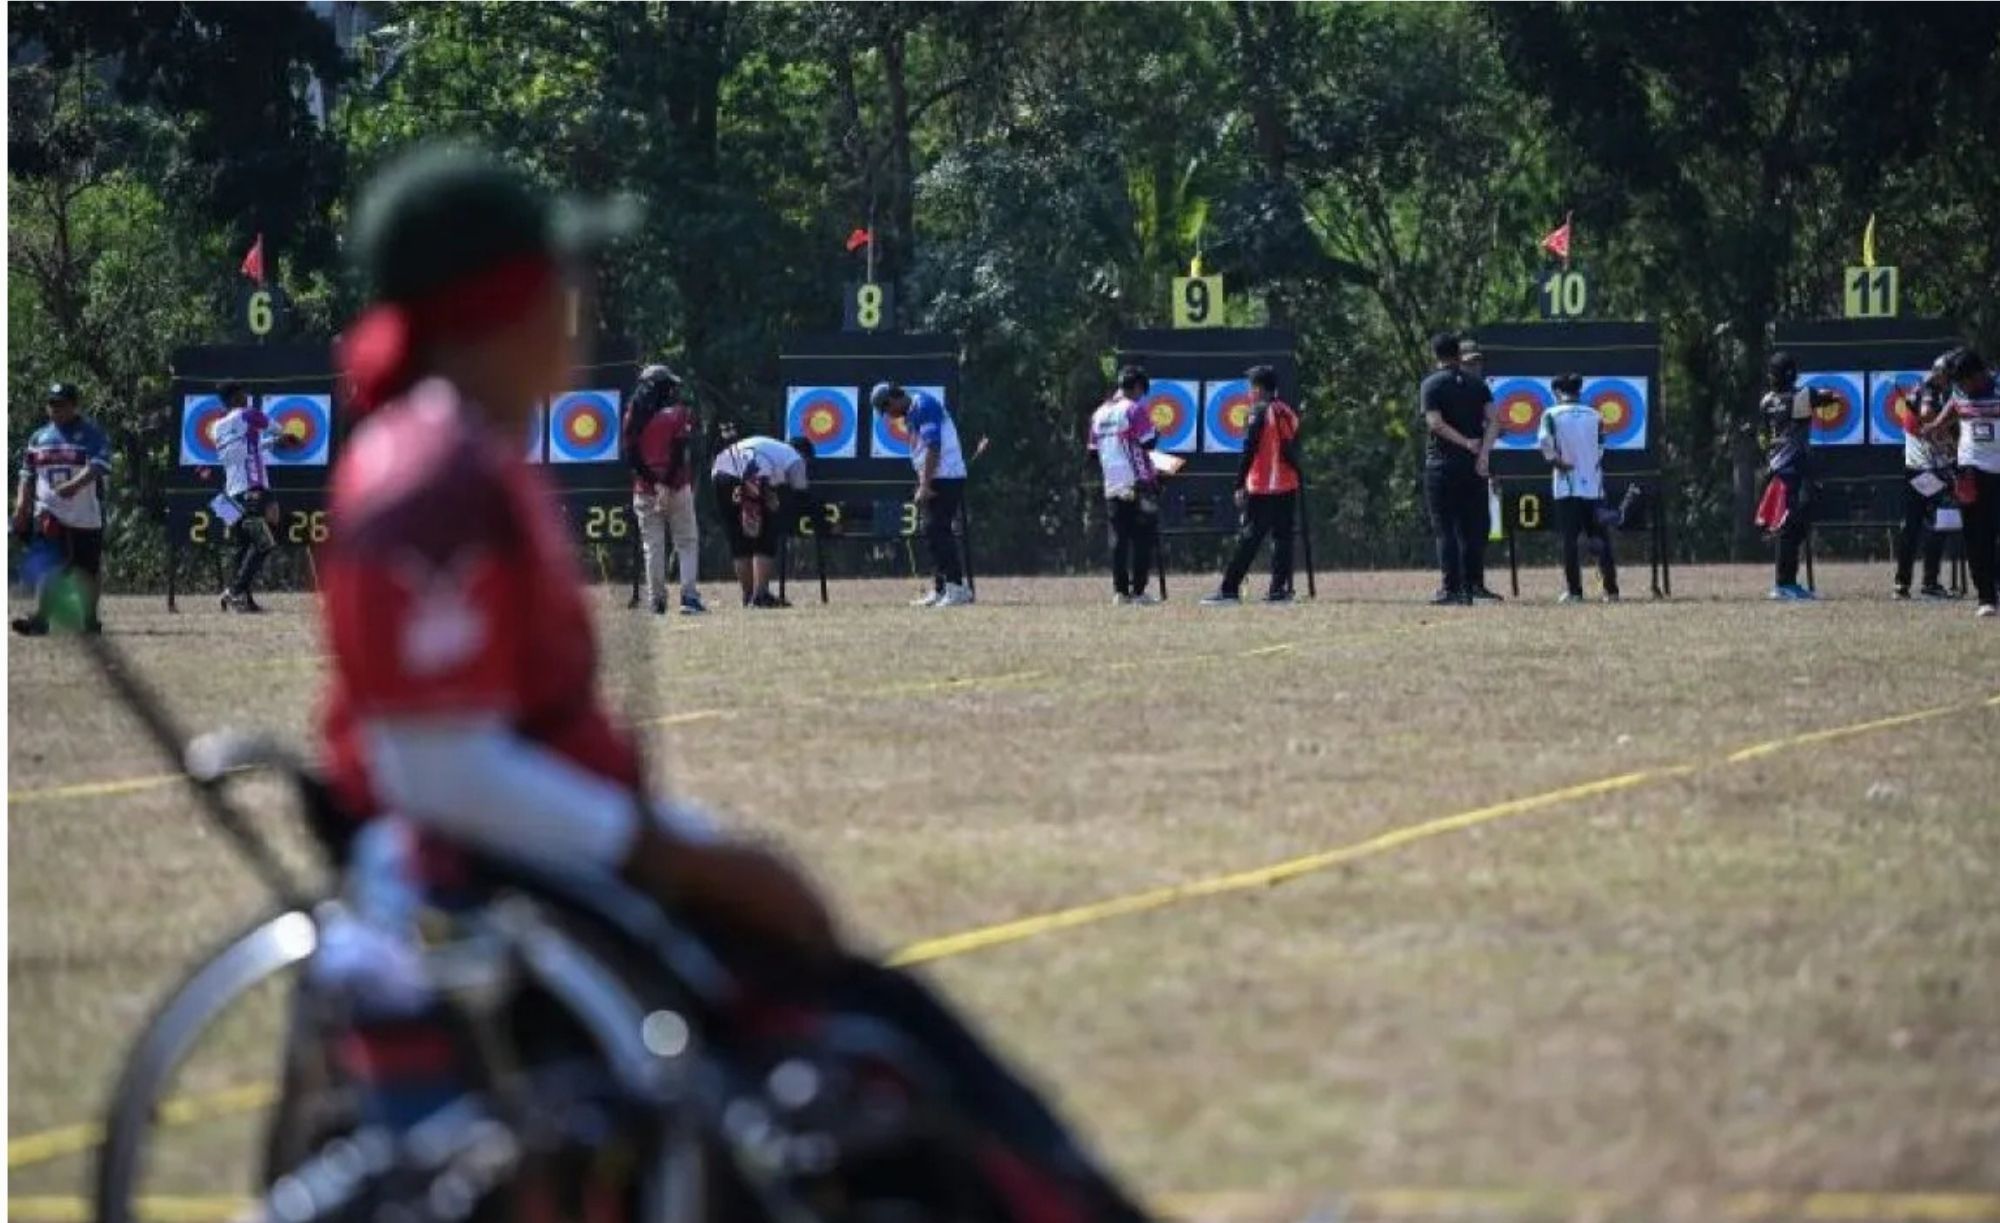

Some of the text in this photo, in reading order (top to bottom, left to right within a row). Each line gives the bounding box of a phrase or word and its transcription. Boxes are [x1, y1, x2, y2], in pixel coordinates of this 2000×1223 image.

[249, 291, 273, 335] 6
[857, 284, 882, 328] 8
[1186, 279, 1209, 322] 9
[1544, 273, 1586, 314] 10
[1852, 271, 1891, 314] 11
[288, 511, 330, 542] 26
[586, 506, 627, 538] 26
